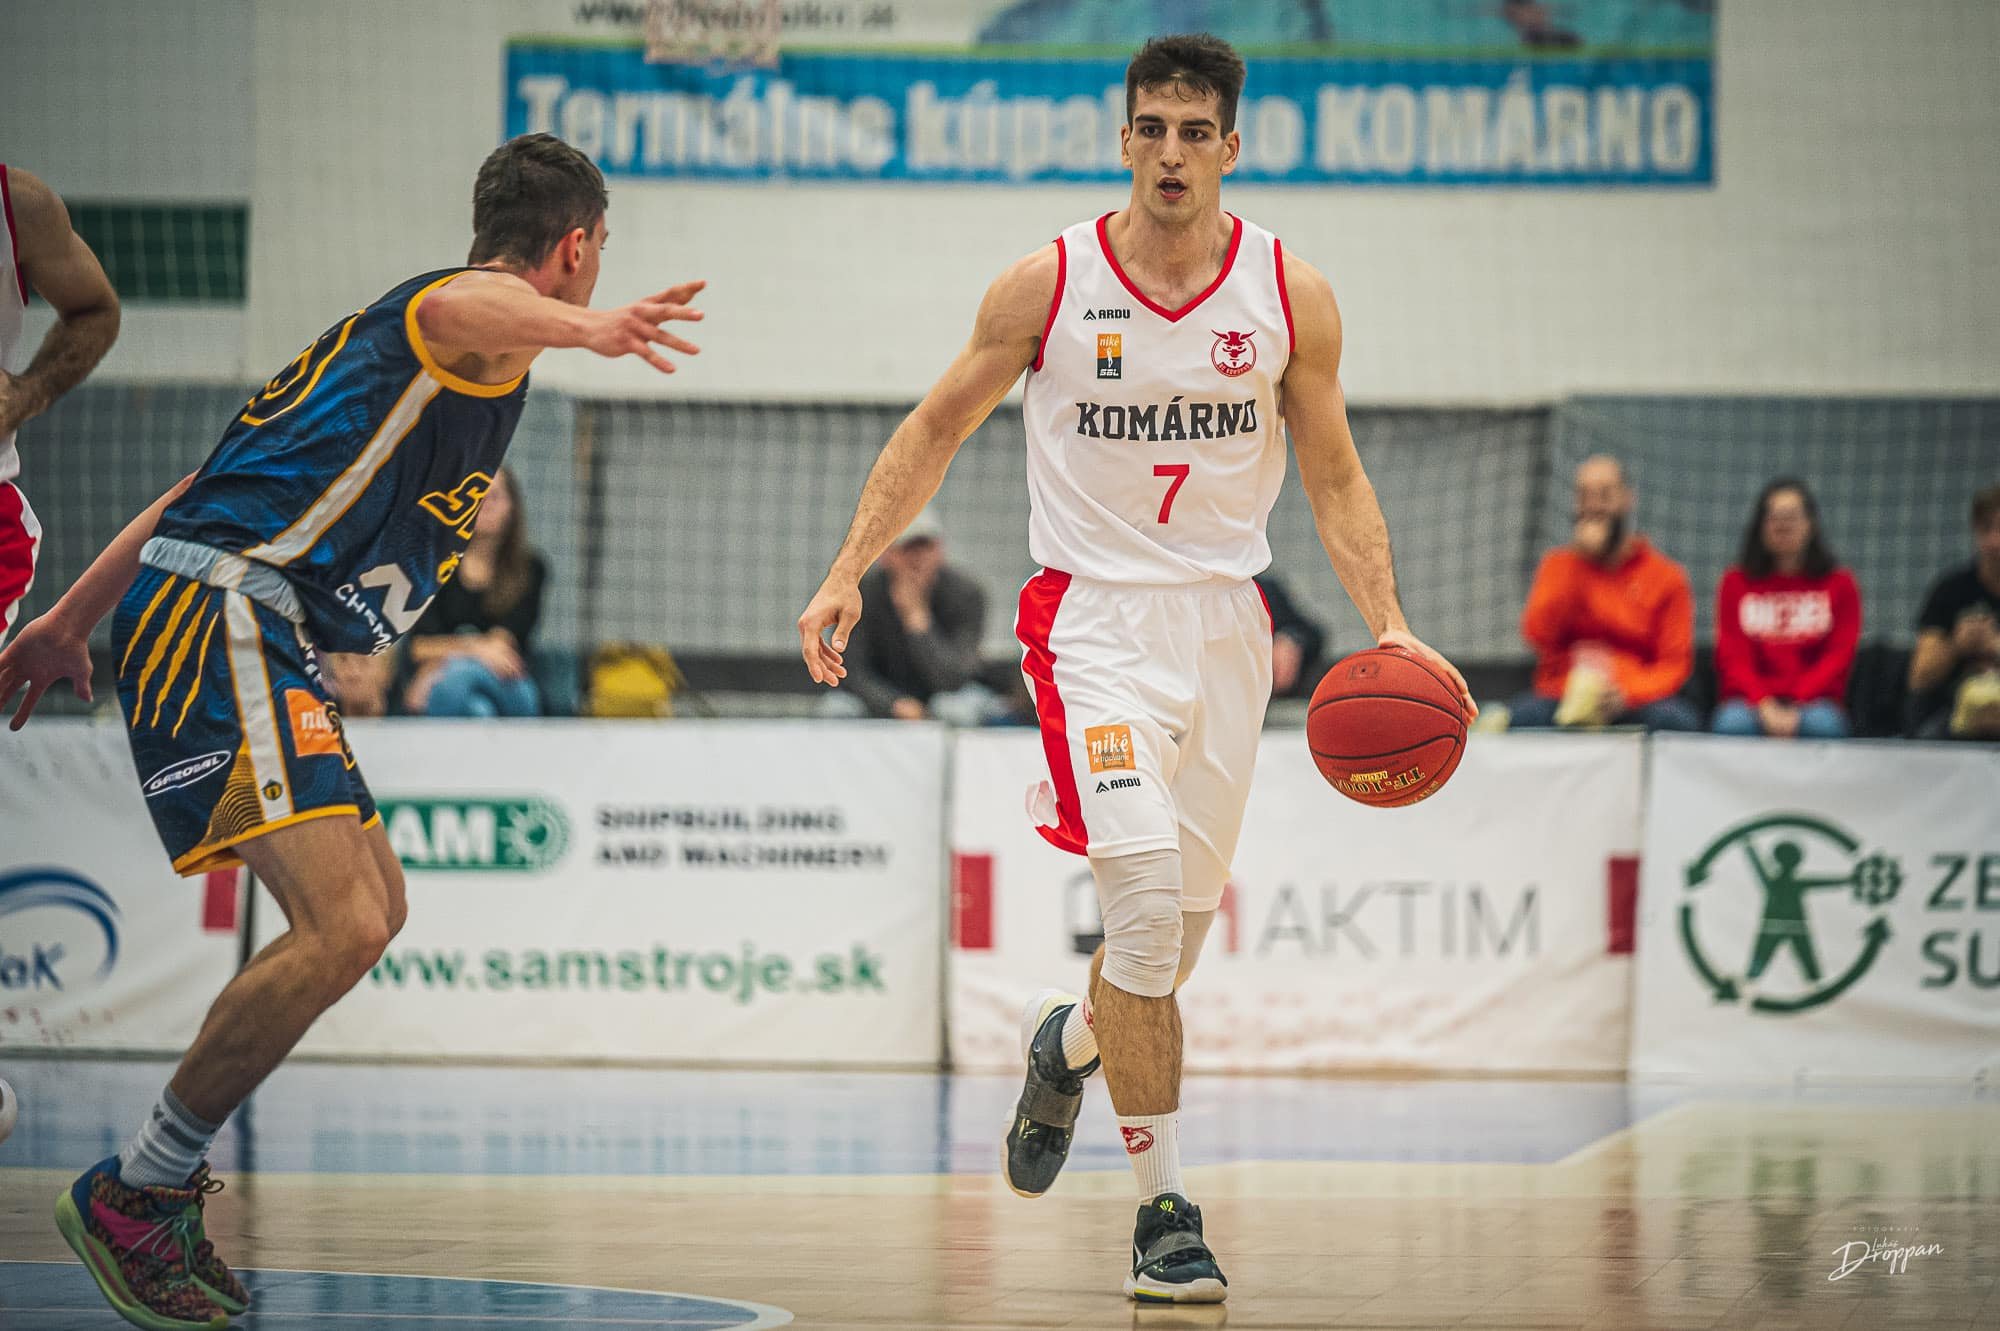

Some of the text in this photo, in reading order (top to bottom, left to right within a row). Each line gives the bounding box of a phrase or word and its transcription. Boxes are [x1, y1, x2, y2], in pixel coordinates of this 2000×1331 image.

[1314, 66, 1699, 174] KOMÁRNO
[1098, 309, 1131, 320] ARDU
[1075, 396, 1257, 441] KOMÁRNO
[1153, 464, 1190, 524] 7
[1091, 731, 1129, 755] niké
[1110, 778, 1141, 790] ARDU
[388, 804, 496, 865] AM
[1250, 880, 1542, 959] AKTIM
[367, 940, 885, 1002] ww.samstroje.sk
